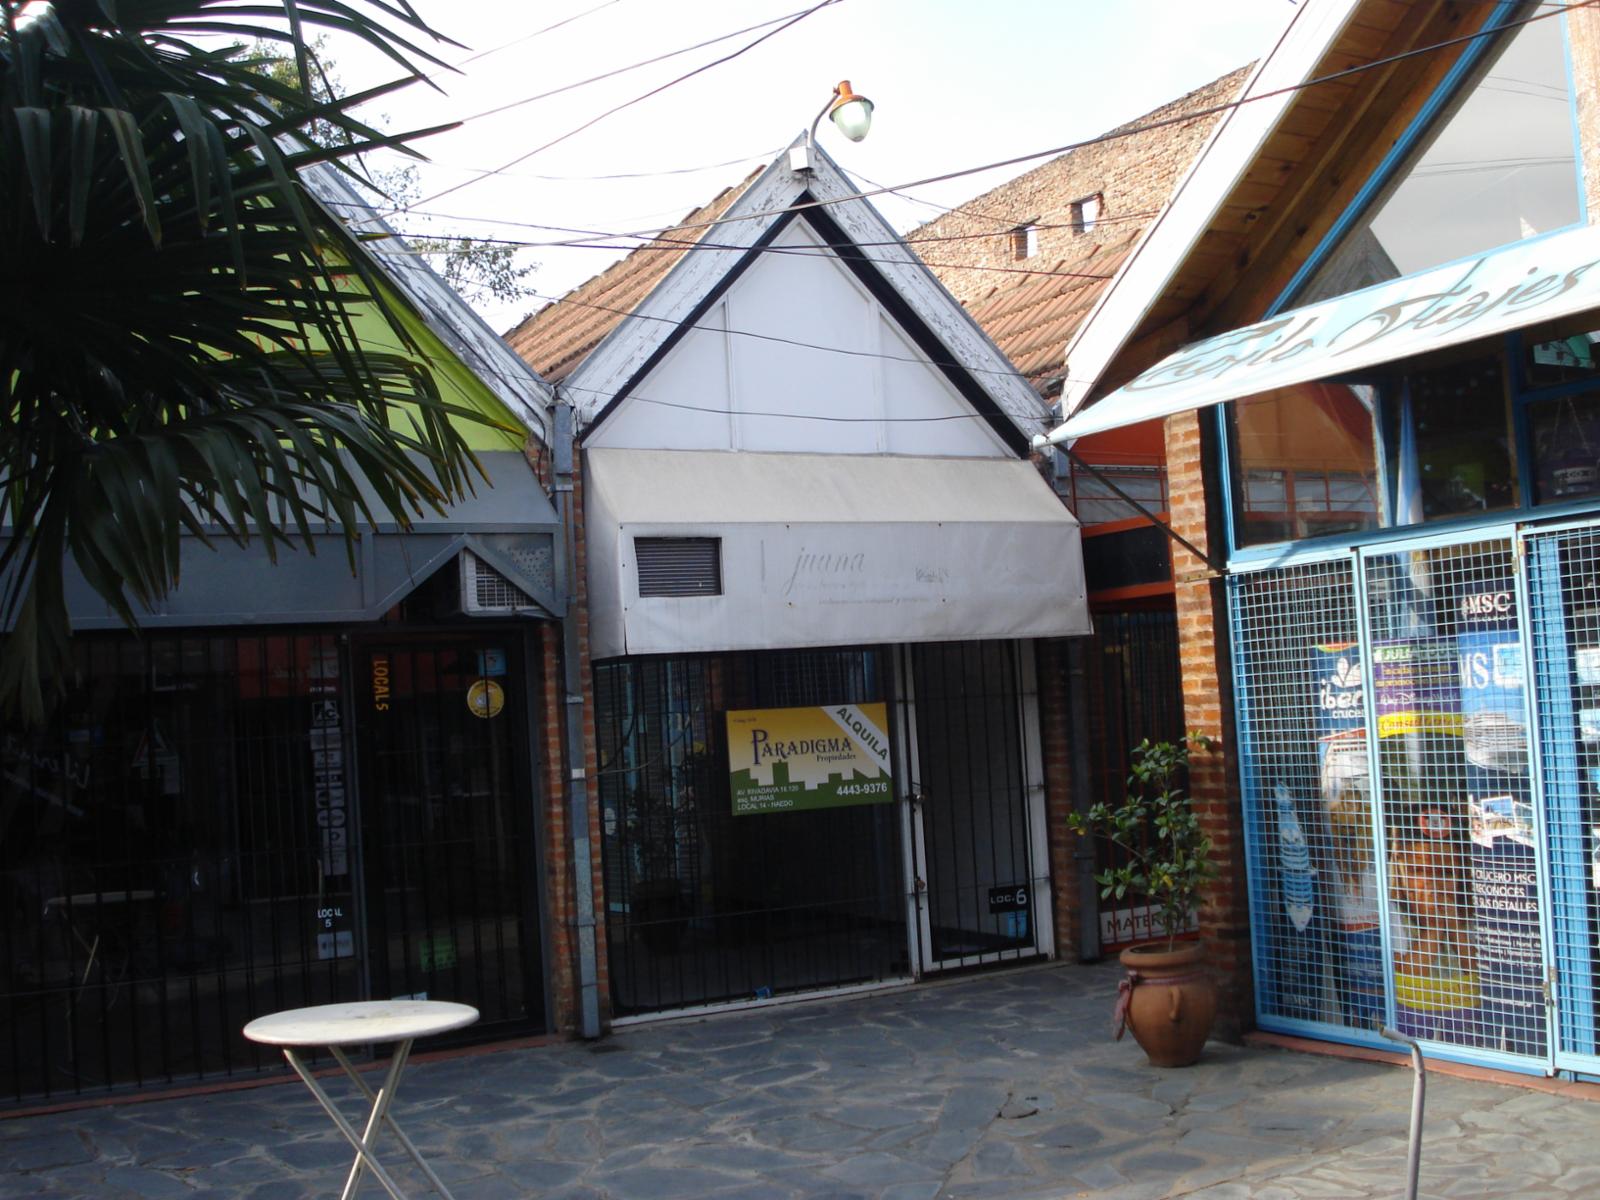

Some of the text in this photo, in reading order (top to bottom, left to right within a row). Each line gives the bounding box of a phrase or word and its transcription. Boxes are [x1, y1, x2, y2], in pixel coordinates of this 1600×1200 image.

[1327, 257, 1600, 358] Viajes
[1469, 592, 1511, 614] MSC
[1332, 708, 1365, 719] cruce
[836, 706, 889, 761] ALQUILA
[751, 728, 853, 766] PARADIGMA
[816, 751, 857, 764] Propiedades
[836, 782, 888, 796] 4443-9376
[737, 803, 757, 811] LOCAL
[1514, 872, 1536, 885] MSC
[1016, 888, 1027, 905] 6
[1492, 899, 1537, 912] DETALLES
[325, 918, 332, 928] 5
